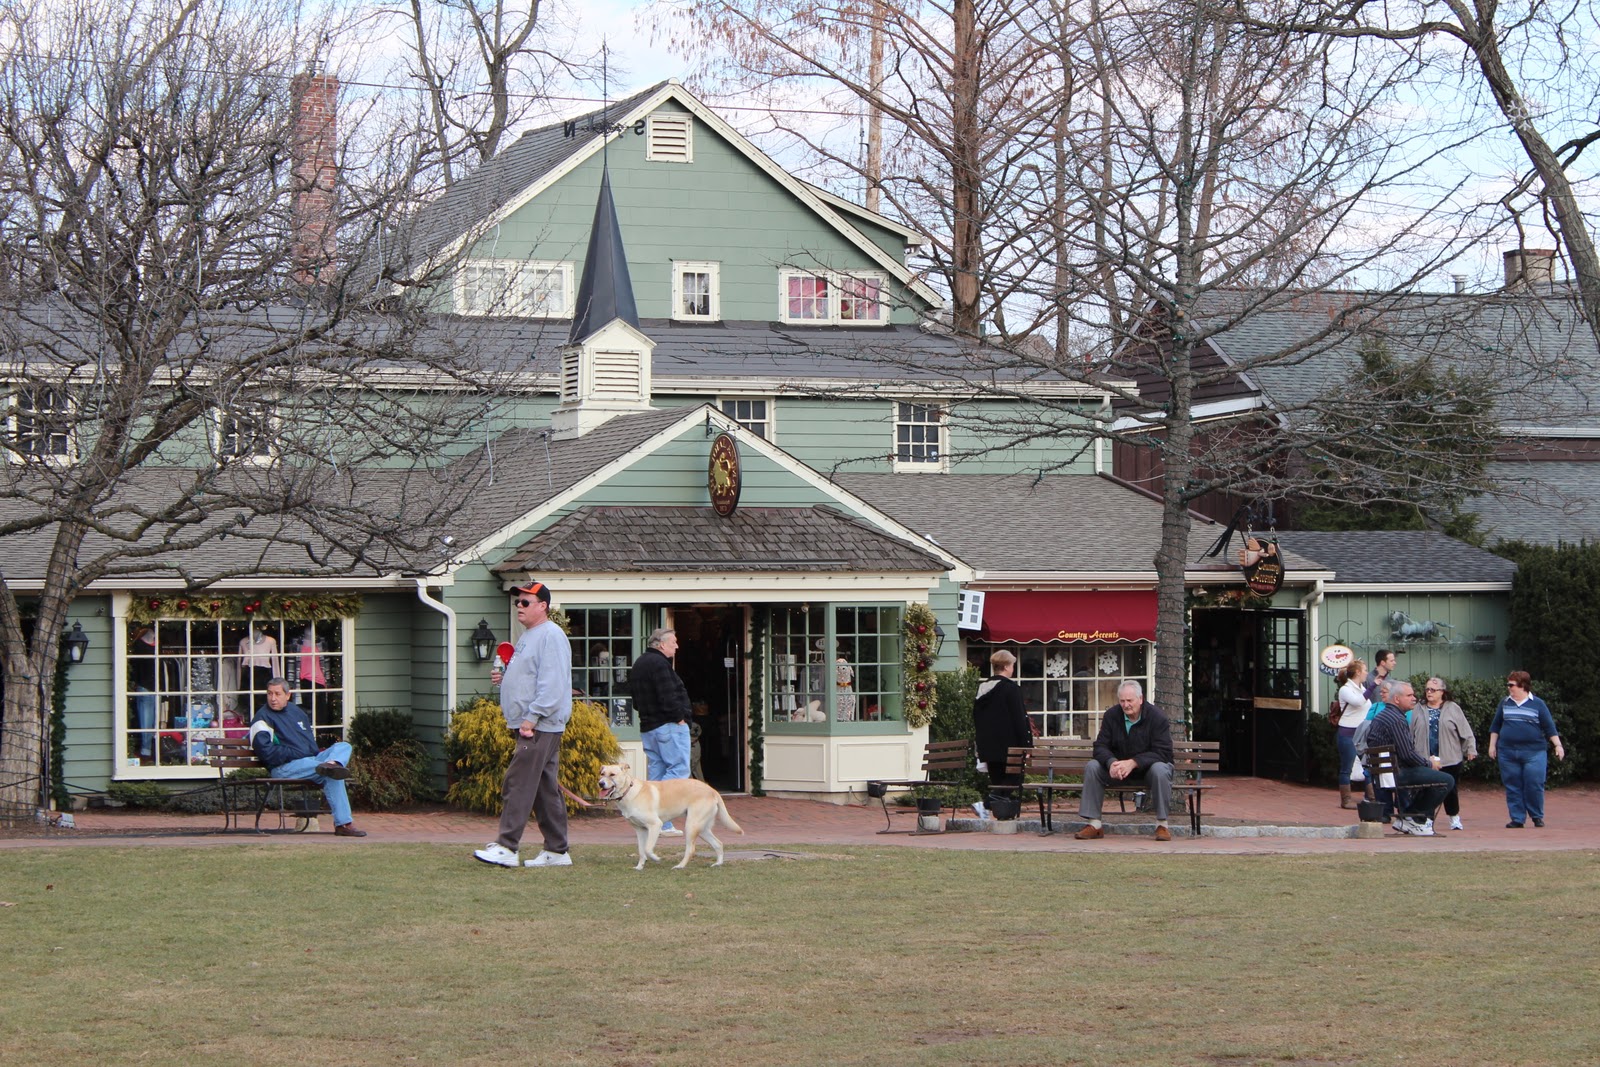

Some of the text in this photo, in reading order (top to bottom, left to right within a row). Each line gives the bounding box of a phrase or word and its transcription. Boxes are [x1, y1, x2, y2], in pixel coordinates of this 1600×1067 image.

[1257, 560, 1279, 575] Country
[1057, 629, 1119, 640] Country Accents
